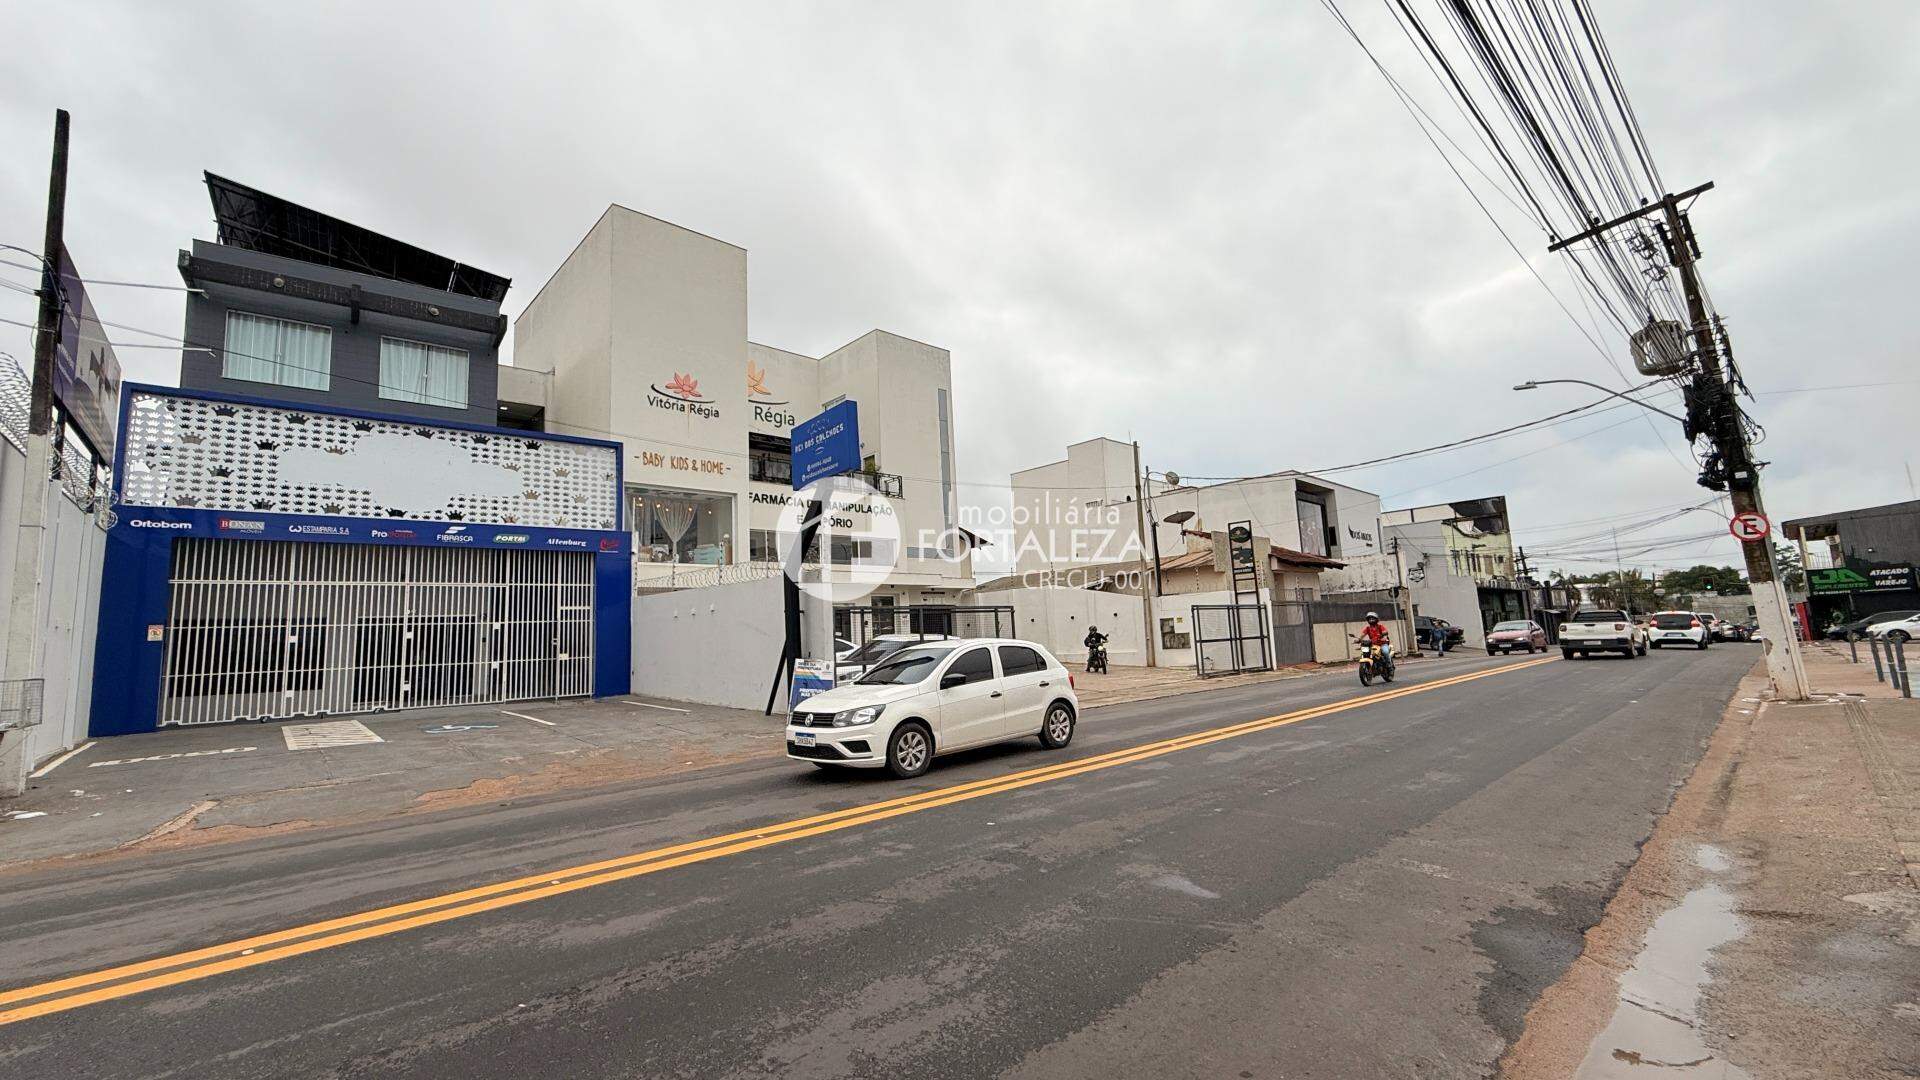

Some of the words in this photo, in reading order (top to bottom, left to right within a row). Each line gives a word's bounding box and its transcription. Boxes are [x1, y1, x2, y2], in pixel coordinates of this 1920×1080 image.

[647, 395, 685, 412] Vitória
[689, 403, 719, 419] Régia
[754, 406, 795, 428] Régia
[642, 451, 665, 468] BABY
[671, 455, 689, 471] KIDS
[692, 459, 698, 472] &
[701, 459, 724, 475] HOME
[749, 492, 804, 508] FARMÁCIA
[130, 519, 192, 529] Ortobom
[436, 534, 474, 542] FIBRASCA
[1869, 567, 1909, 576] ATACADO
[1875, 578, 1908, 587] VAREJO
